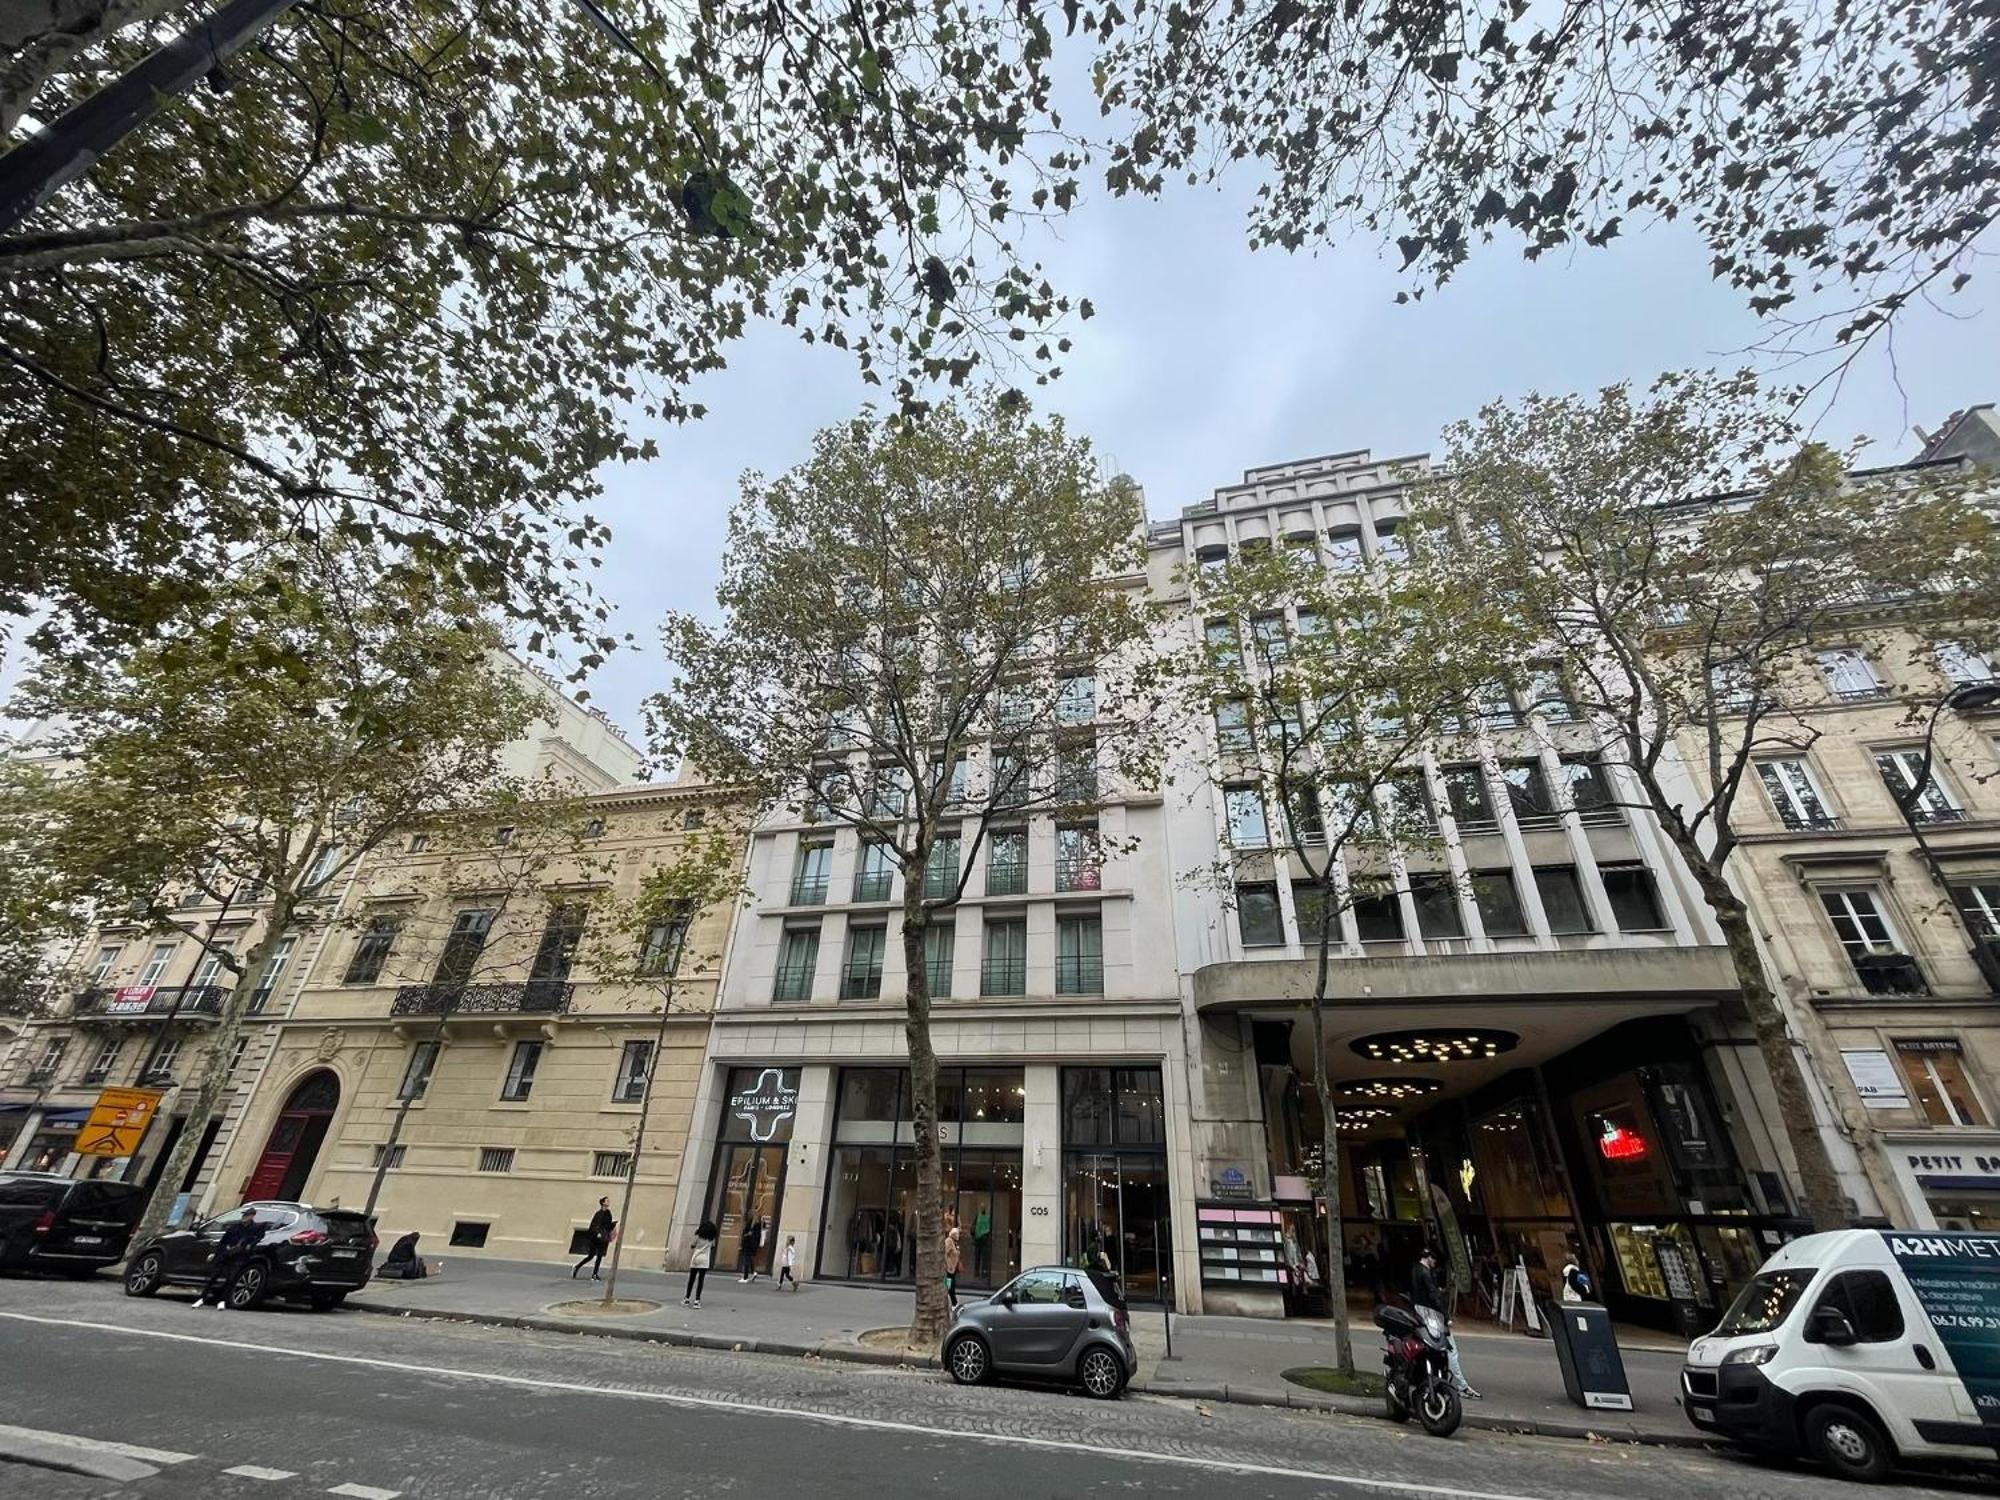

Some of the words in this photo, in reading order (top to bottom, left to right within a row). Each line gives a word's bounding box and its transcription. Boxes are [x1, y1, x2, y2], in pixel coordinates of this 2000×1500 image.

[731, 1096, 770, 1106] EPILIUM
[773, 1096, 780, 1105] &
[1907, 1156, 1962, 1170] PETIT
[1030, 1206, 1048, 1216] COS
